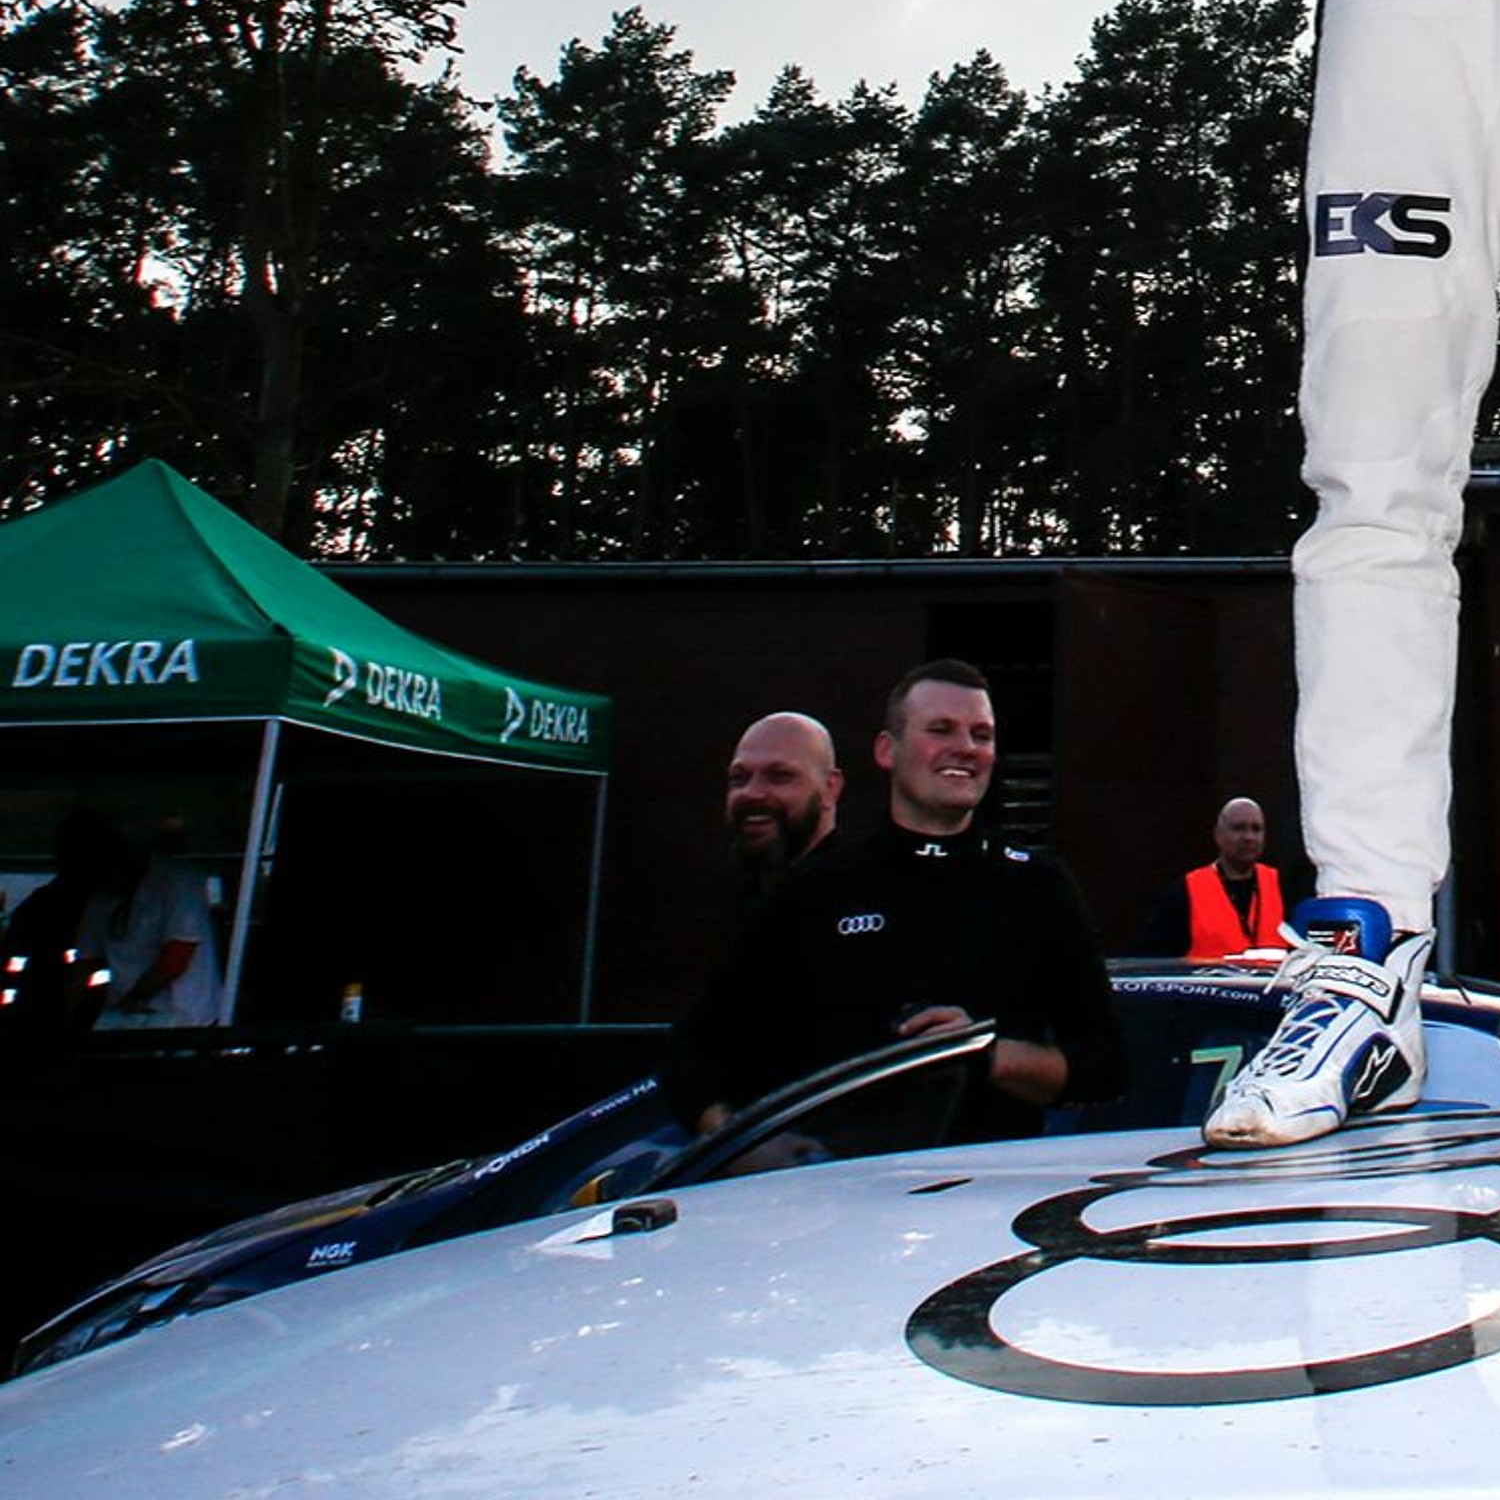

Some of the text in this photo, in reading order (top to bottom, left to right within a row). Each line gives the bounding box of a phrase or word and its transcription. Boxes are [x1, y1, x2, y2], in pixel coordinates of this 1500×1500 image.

[1315, 192, 1452, 259] EKS
[11, 638, 199, 688] DEKRA
[367, 662, 442, 721] DEKRA
[529, 700, 589, 744] DEKRA
[1111, 981, 1260, 1001] EOT-SPORT.com
[309, 1241, 358, 1260] NGK
